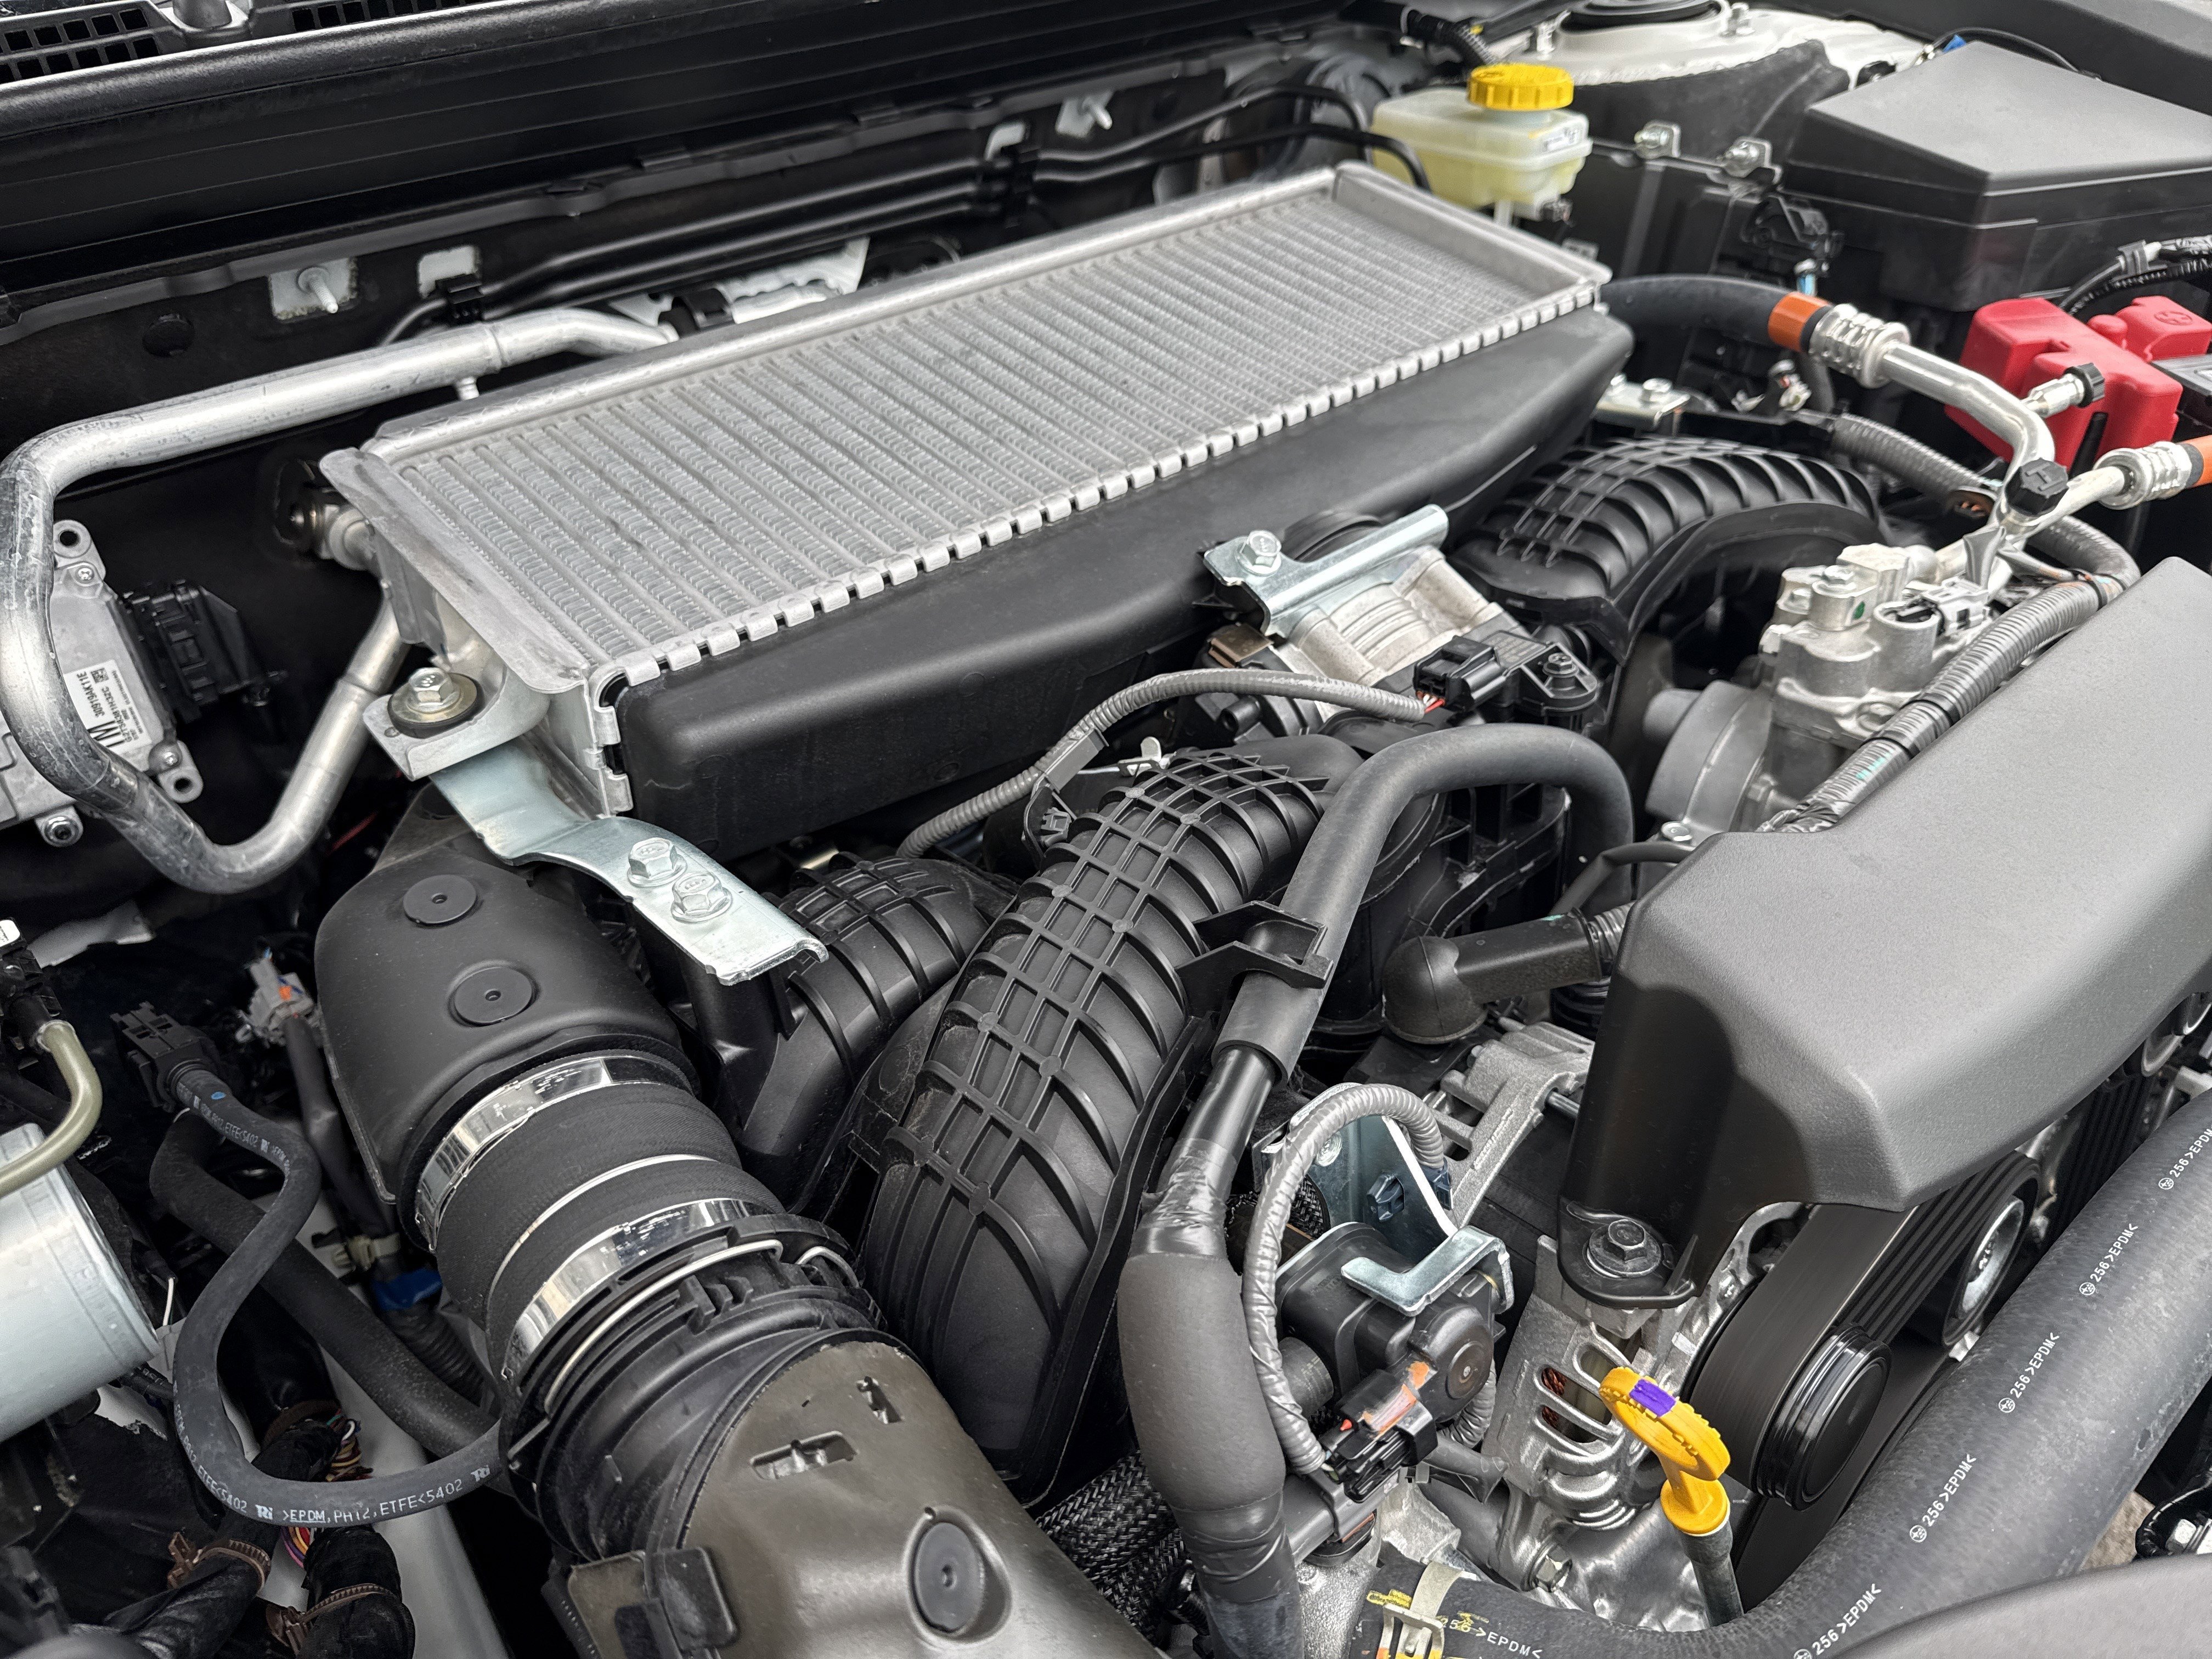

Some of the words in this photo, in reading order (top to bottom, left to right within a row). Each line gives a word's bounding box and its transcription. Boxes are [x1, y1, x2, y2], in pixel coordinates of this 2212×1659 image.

[2169, 1158, 2189, 1178] 256
[2184, 1124, 2212, 1159] >EPDM
[2090, 1261, 2110, 1282] 256
[2104, 1223, 2138, 1262] >EPDM<
[2010, 1374, 2030, 1398] 256
[2024, 1332, 2060, 1376] >EPDM<
[1922, 1500, 1945, 1527] 256
[1939, 1454, 1977, 1502] >EPDM<
[1476, 1627, 1544, 1659] >EPDM<
[1812, 1629, 1839, 1656] 256
[1836, 1583, 1882, 1634] >EPDM<
